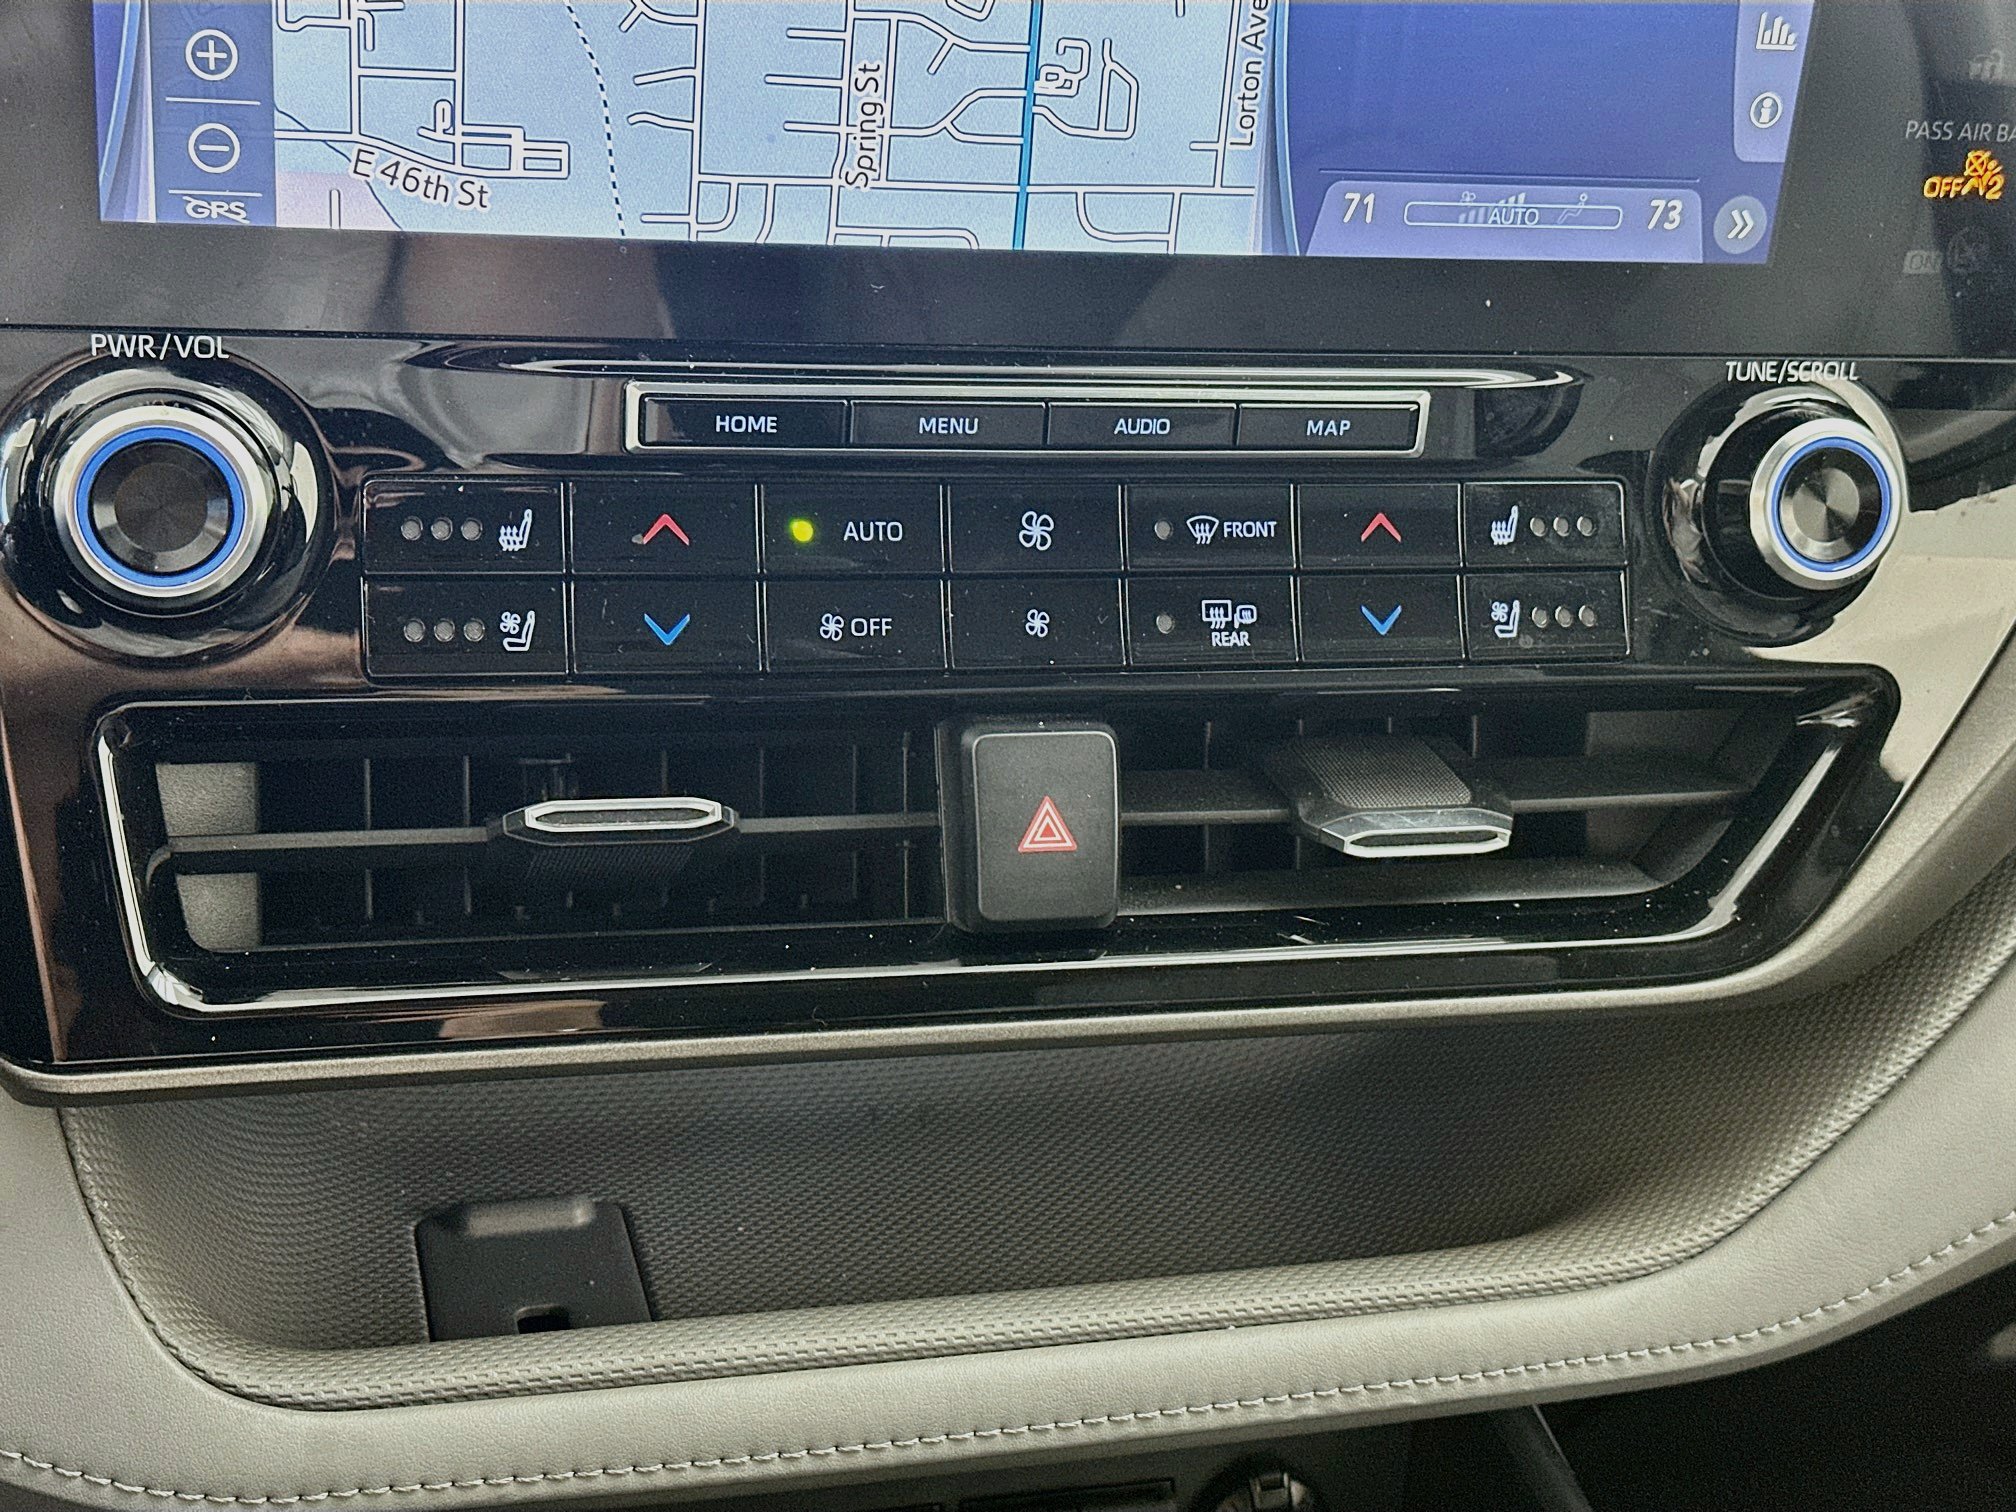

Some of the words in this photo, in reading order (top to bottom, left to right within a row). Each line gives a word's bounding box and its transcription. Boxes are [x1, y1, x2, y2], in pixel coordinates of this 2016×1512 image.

[1241, 0, 1269, 51] Ave
[854, 63, 880, 93] St
[1229, 60, 1262, 146] Lorton
[1905, 119, 1954, 141] PASS
[1957, 123, 1993, 142] AIR
[845, 101, 884, 188] Spring
[353, 148, 375, 178] E
[380, 160, 450, 203] 46th
[458, 180, 489, 209] St
[1923, 175, 1966, 199] OFF
[1343, 192, 1376, 224] 71
[1488, 207, 1540, 226] AUTO
[1647, 199, 1683, 230] 73
[91, 333, 230, 361] PWR/VOL
[1725, 359, 1859, 384] TUNE/SCROLL
[715, 415, 778, 434] HOME
[917, 416, 979, 435] MENU
[1114, 417, 1172, 436] AUDIO
[1305, 419, 1351, 437] MAP
[843, 521, 903, 542] AUTO
[1222, 520, 1277, 539] FRONT
[850, 617, 892, 637] OFF
[1211, 631, 1251, 648] REAR
